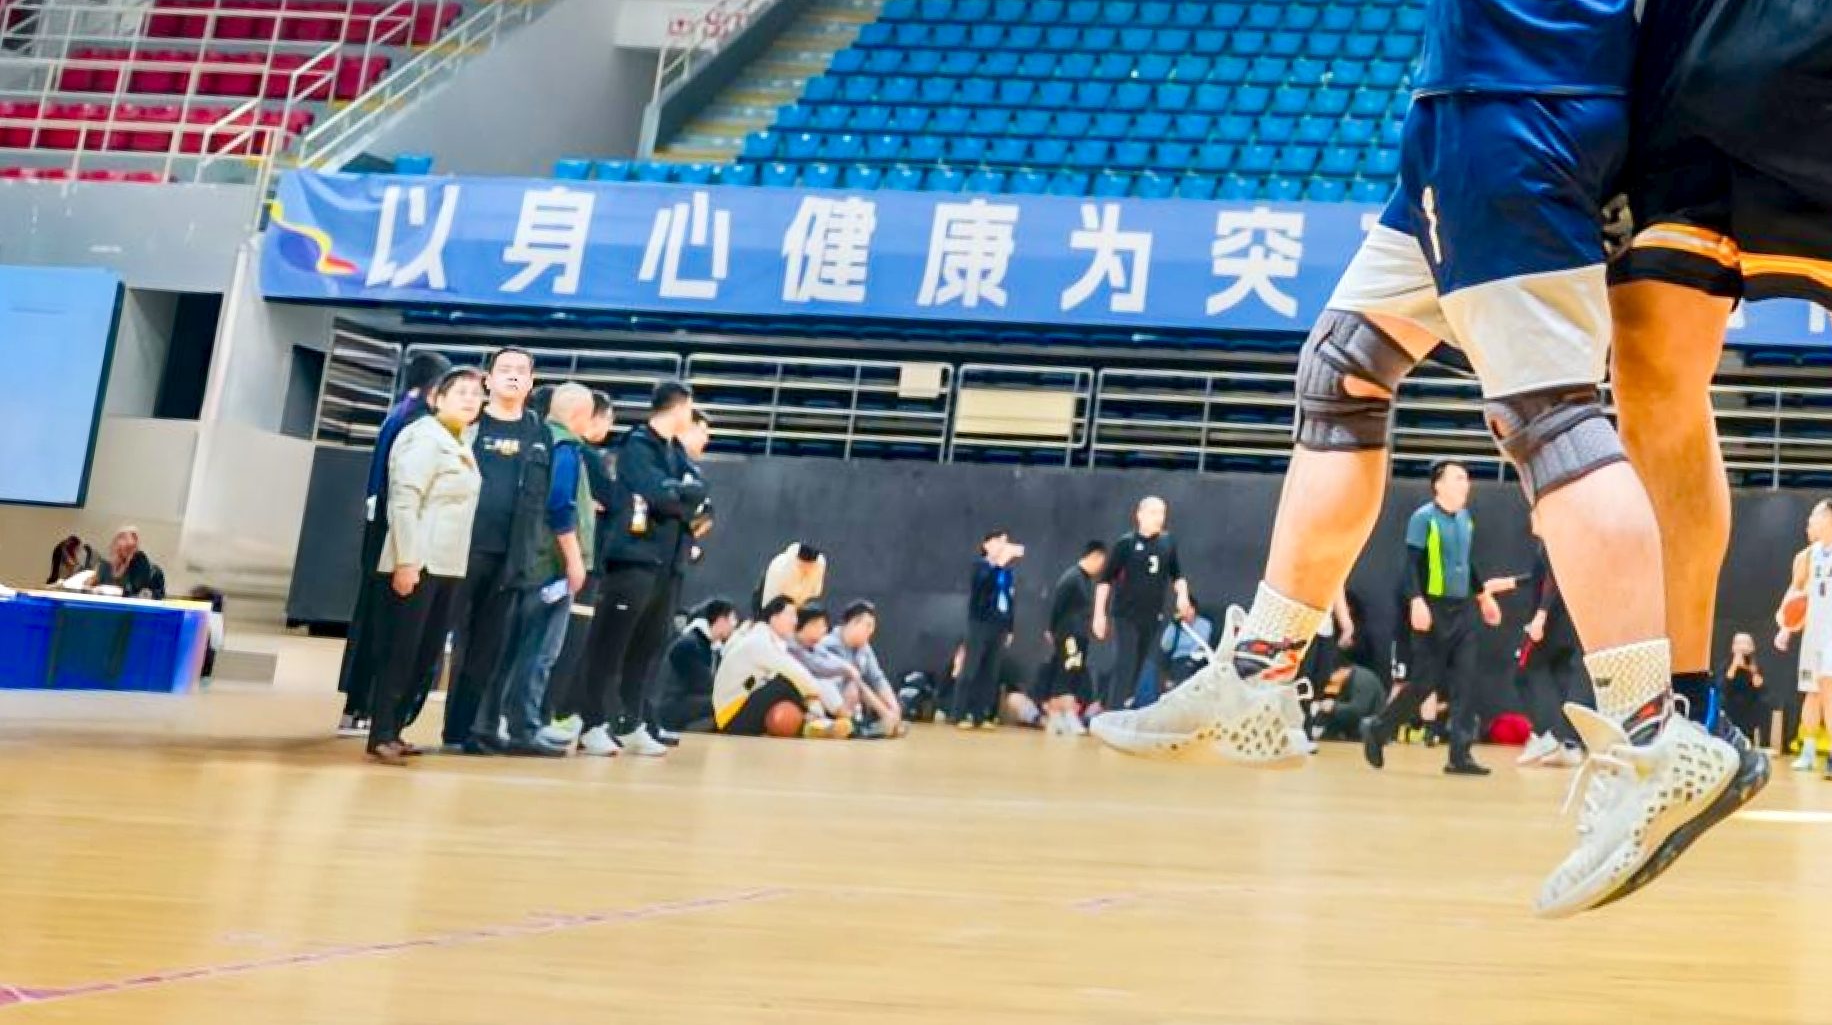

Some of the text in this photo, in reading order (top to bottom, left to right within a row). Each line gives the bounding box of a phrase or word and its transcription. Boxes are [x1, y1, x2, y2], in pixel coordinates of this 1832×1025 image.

[364, 183, 1382, 319] 以身心健康为突
